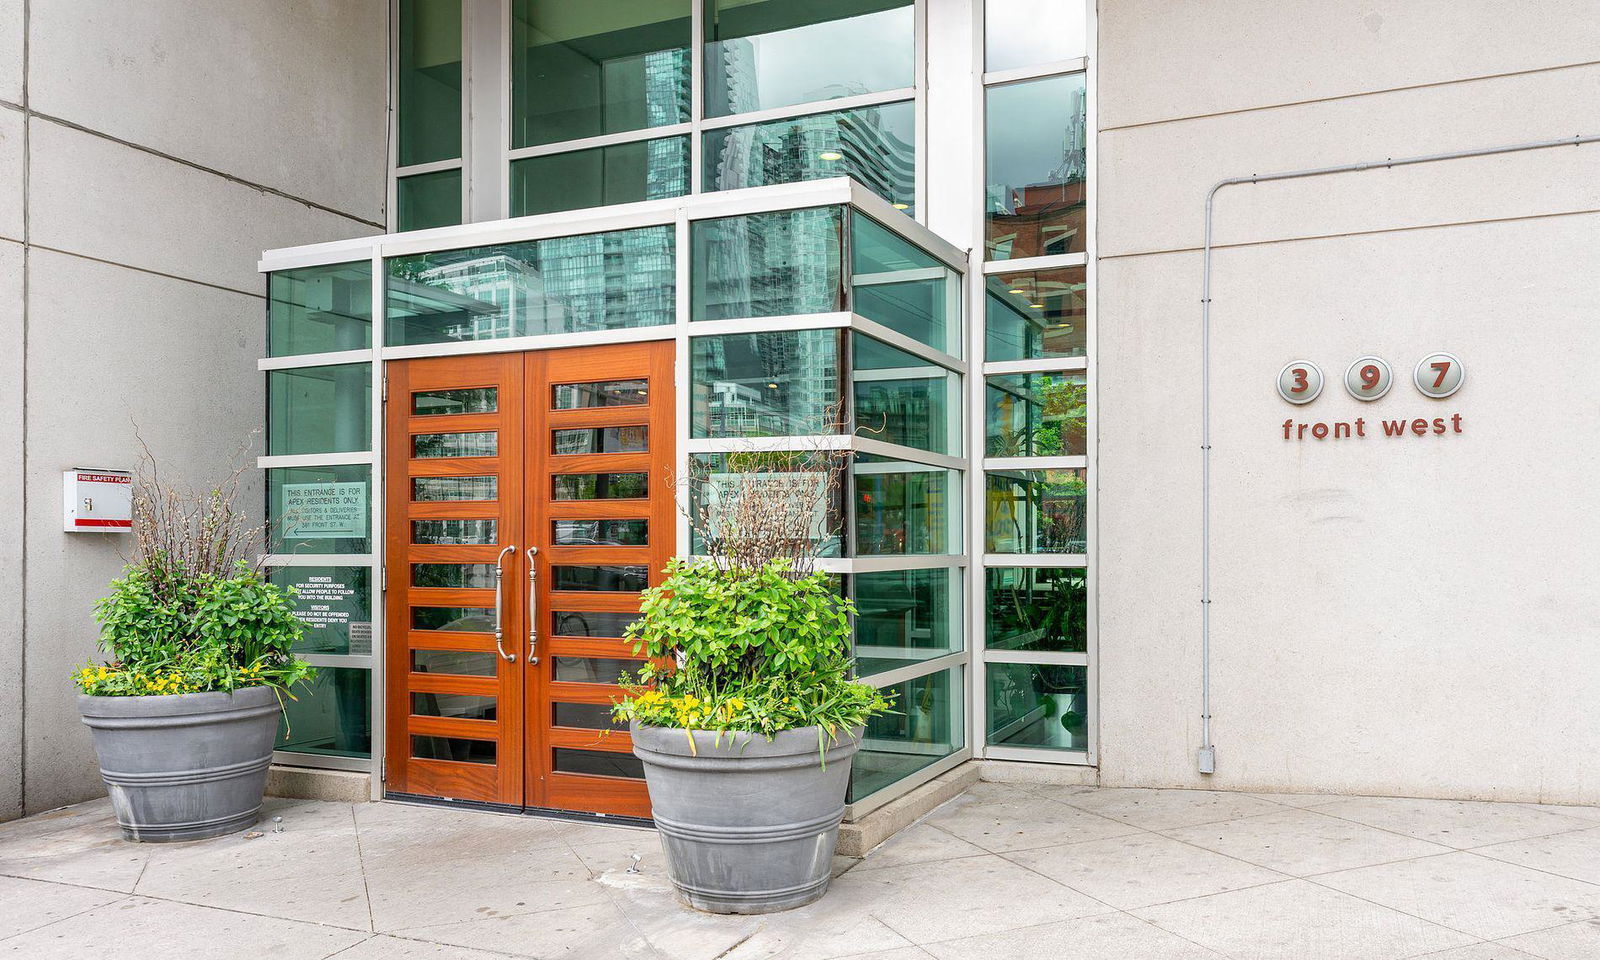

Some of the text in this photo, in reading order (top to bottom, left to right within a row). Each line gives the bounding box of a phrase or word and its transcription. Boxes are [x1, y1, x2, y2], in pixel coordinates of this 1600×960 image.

[1282, 413, 1463, 440] front west
[716, 480, 735, 488] THIS
[304, 488, 336, 496] ENTRANCE
